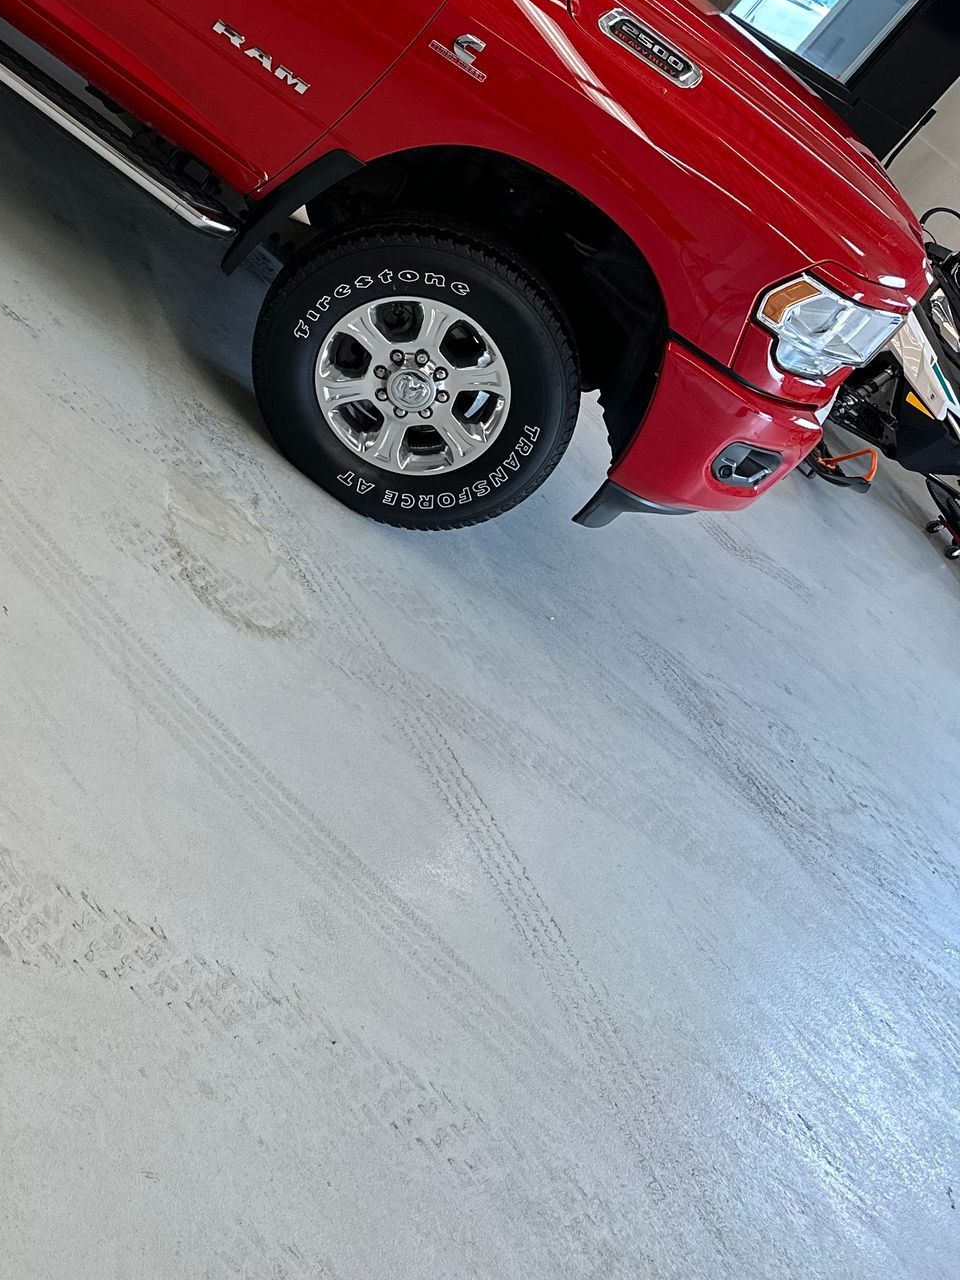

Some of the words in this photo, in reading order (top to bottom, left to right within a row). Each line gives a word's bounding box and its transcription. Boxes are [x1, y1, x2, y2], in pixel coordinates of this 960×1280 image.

[212, 18, 311, 95] RAM
[614, 30, 648, 55] HEAVY
[648, 54, 676, 76] DUTY
[621, 22, 684, 71] 2500
[294, 269, 471, 340] Firestone
[337, 470, 376, 495] AT
[382, 424, 541, 510] TRANSFORCE
